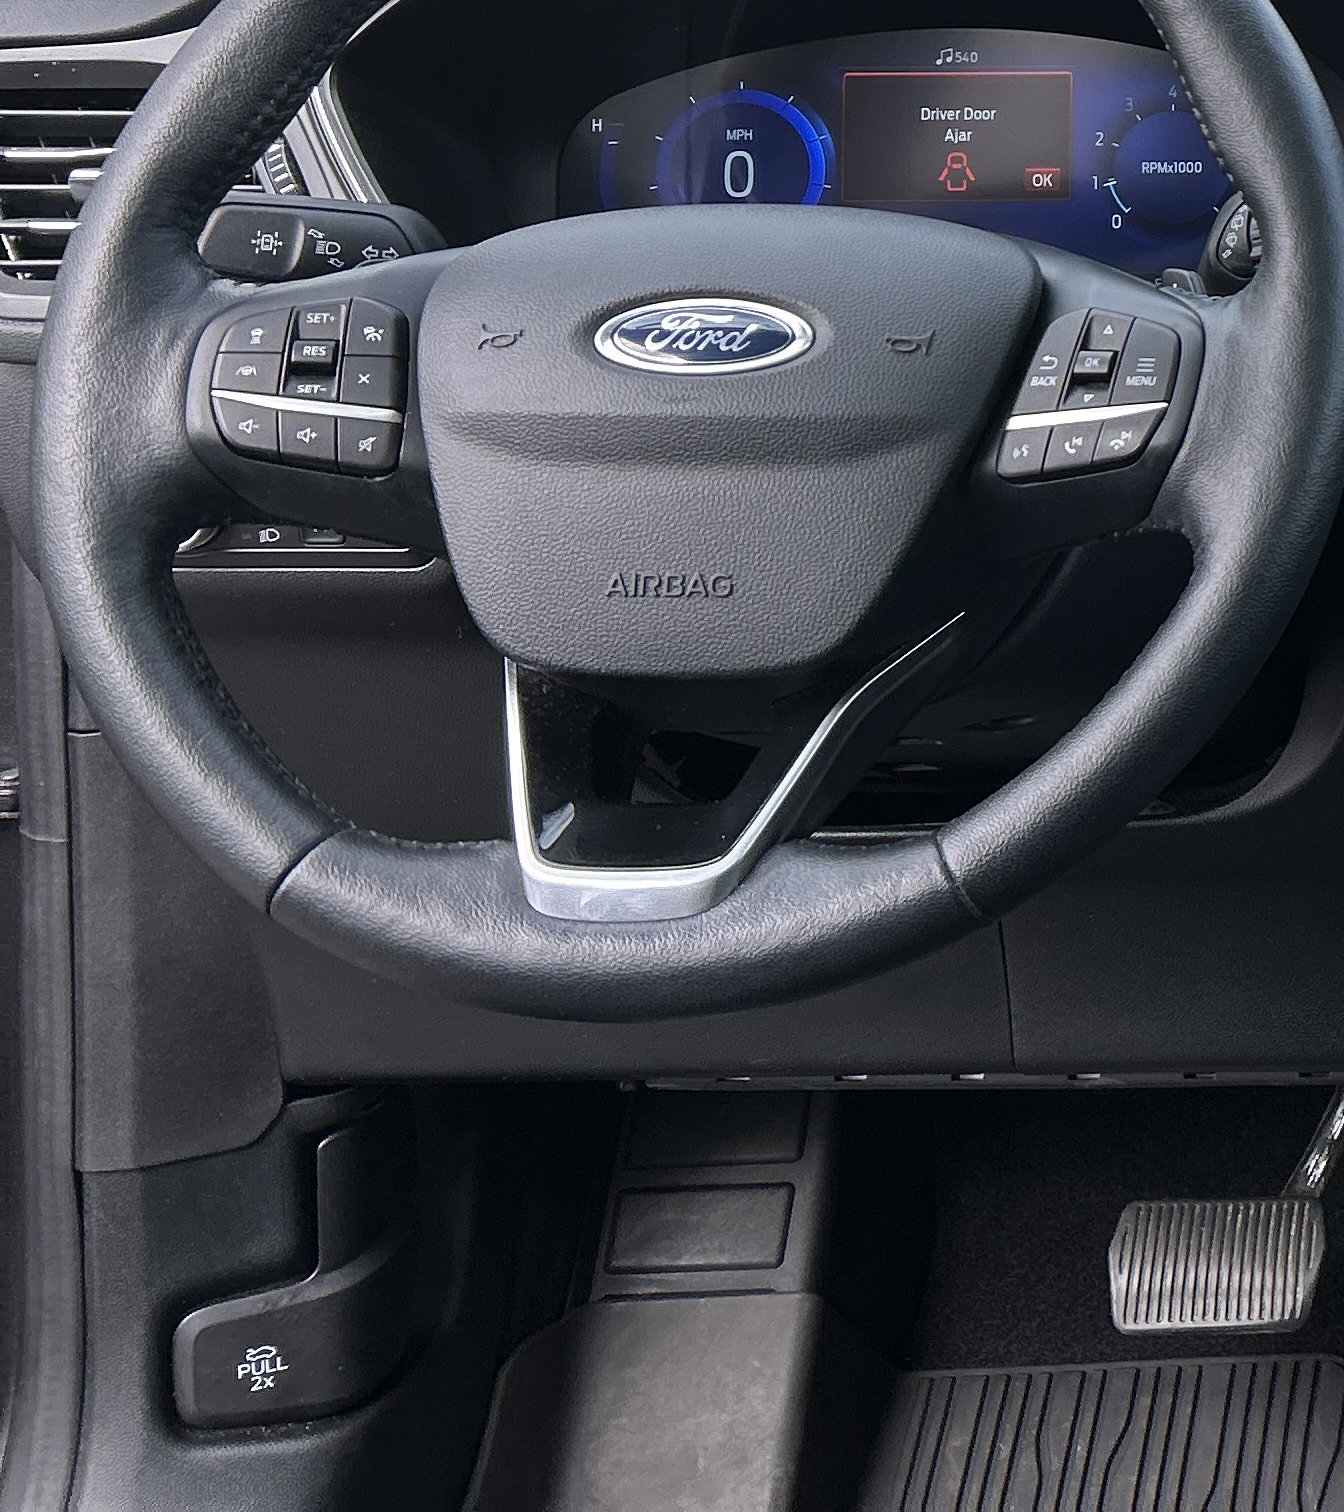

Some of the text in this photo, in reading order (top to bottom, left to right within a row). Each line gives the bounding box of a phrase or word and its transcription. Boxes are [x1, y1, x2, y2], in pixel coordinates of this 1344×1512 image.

[955, 51, 978, 63] 540
[1168, 87, 1177, 98] 4
[1124, 98, 1134, 111] 3
[921, 107, 997, 122] Driver Door
[592, 119, 602, 132] H
[726, 129, 753, 141] MPH
[944, 128, 972, 145] Ajar
[1095, 132, 1104, 146] 2
[723, 150, 754, 198] 0
[1141, 160, 1202, 176] RPMx1000
[1031, 173, 1053, 188] OK
[1111, 215, 1122, 229] 0
[306, 312, 336, 324] SET+
[645, 312, 760, 353] Ford
[303, 345, 327, 357] RES
[1084, 357, 1101, 368] OK
[1030, 375, 1059, 387] BACK
[1125, 375, 1157, 387] MENU
[297, 384, 327, 394] SET-
[605, 571, 735, 600] AIRBAG
[237, 1357, 289, 1380] PULL
